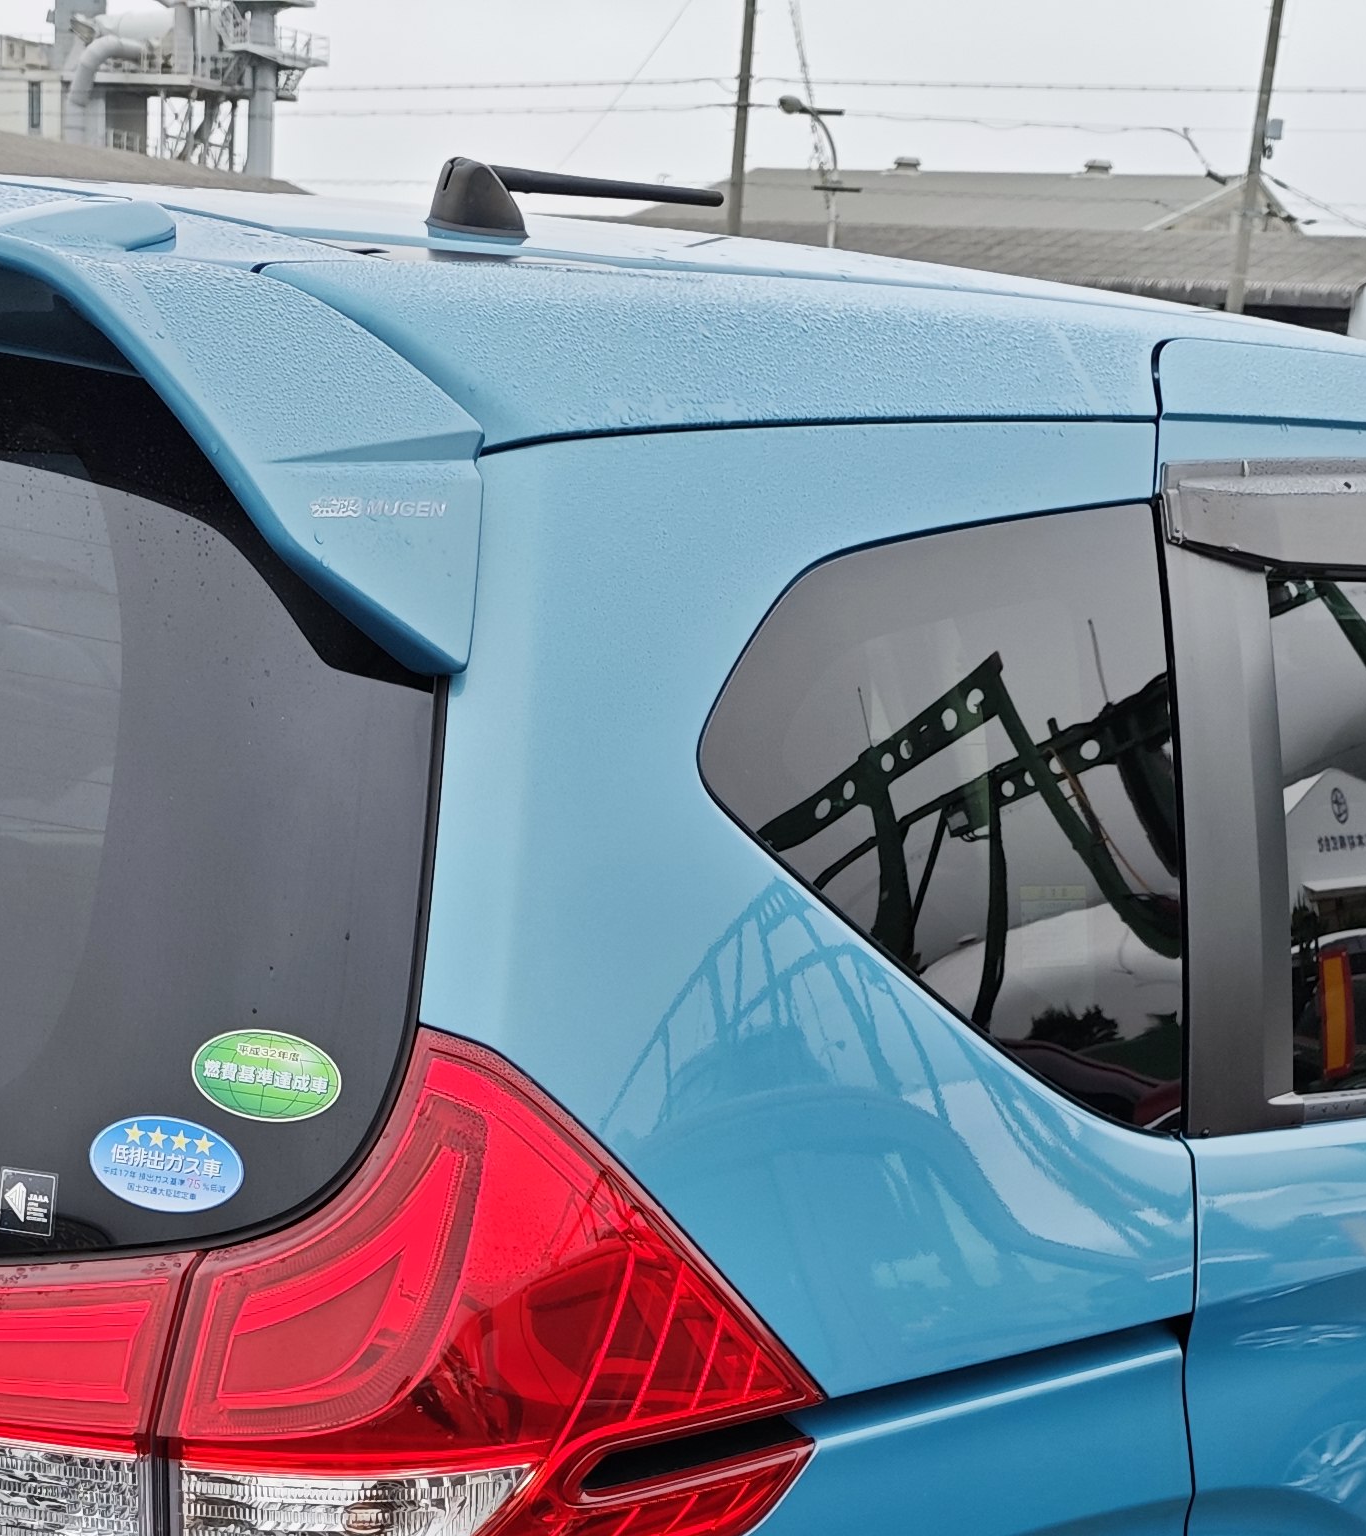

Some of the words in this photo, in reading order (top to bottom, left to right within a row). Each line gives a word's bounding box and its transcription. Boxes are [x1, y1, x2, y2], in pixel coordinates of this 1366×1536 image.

[366, 499, 447, 517] MUGEN
[237, 1043, 301, 1062] 平成32年度
[203, 1059, 329, 1095] 燃費基準達成車
[111, 1143, 223, 1178] 低排出ガス車
